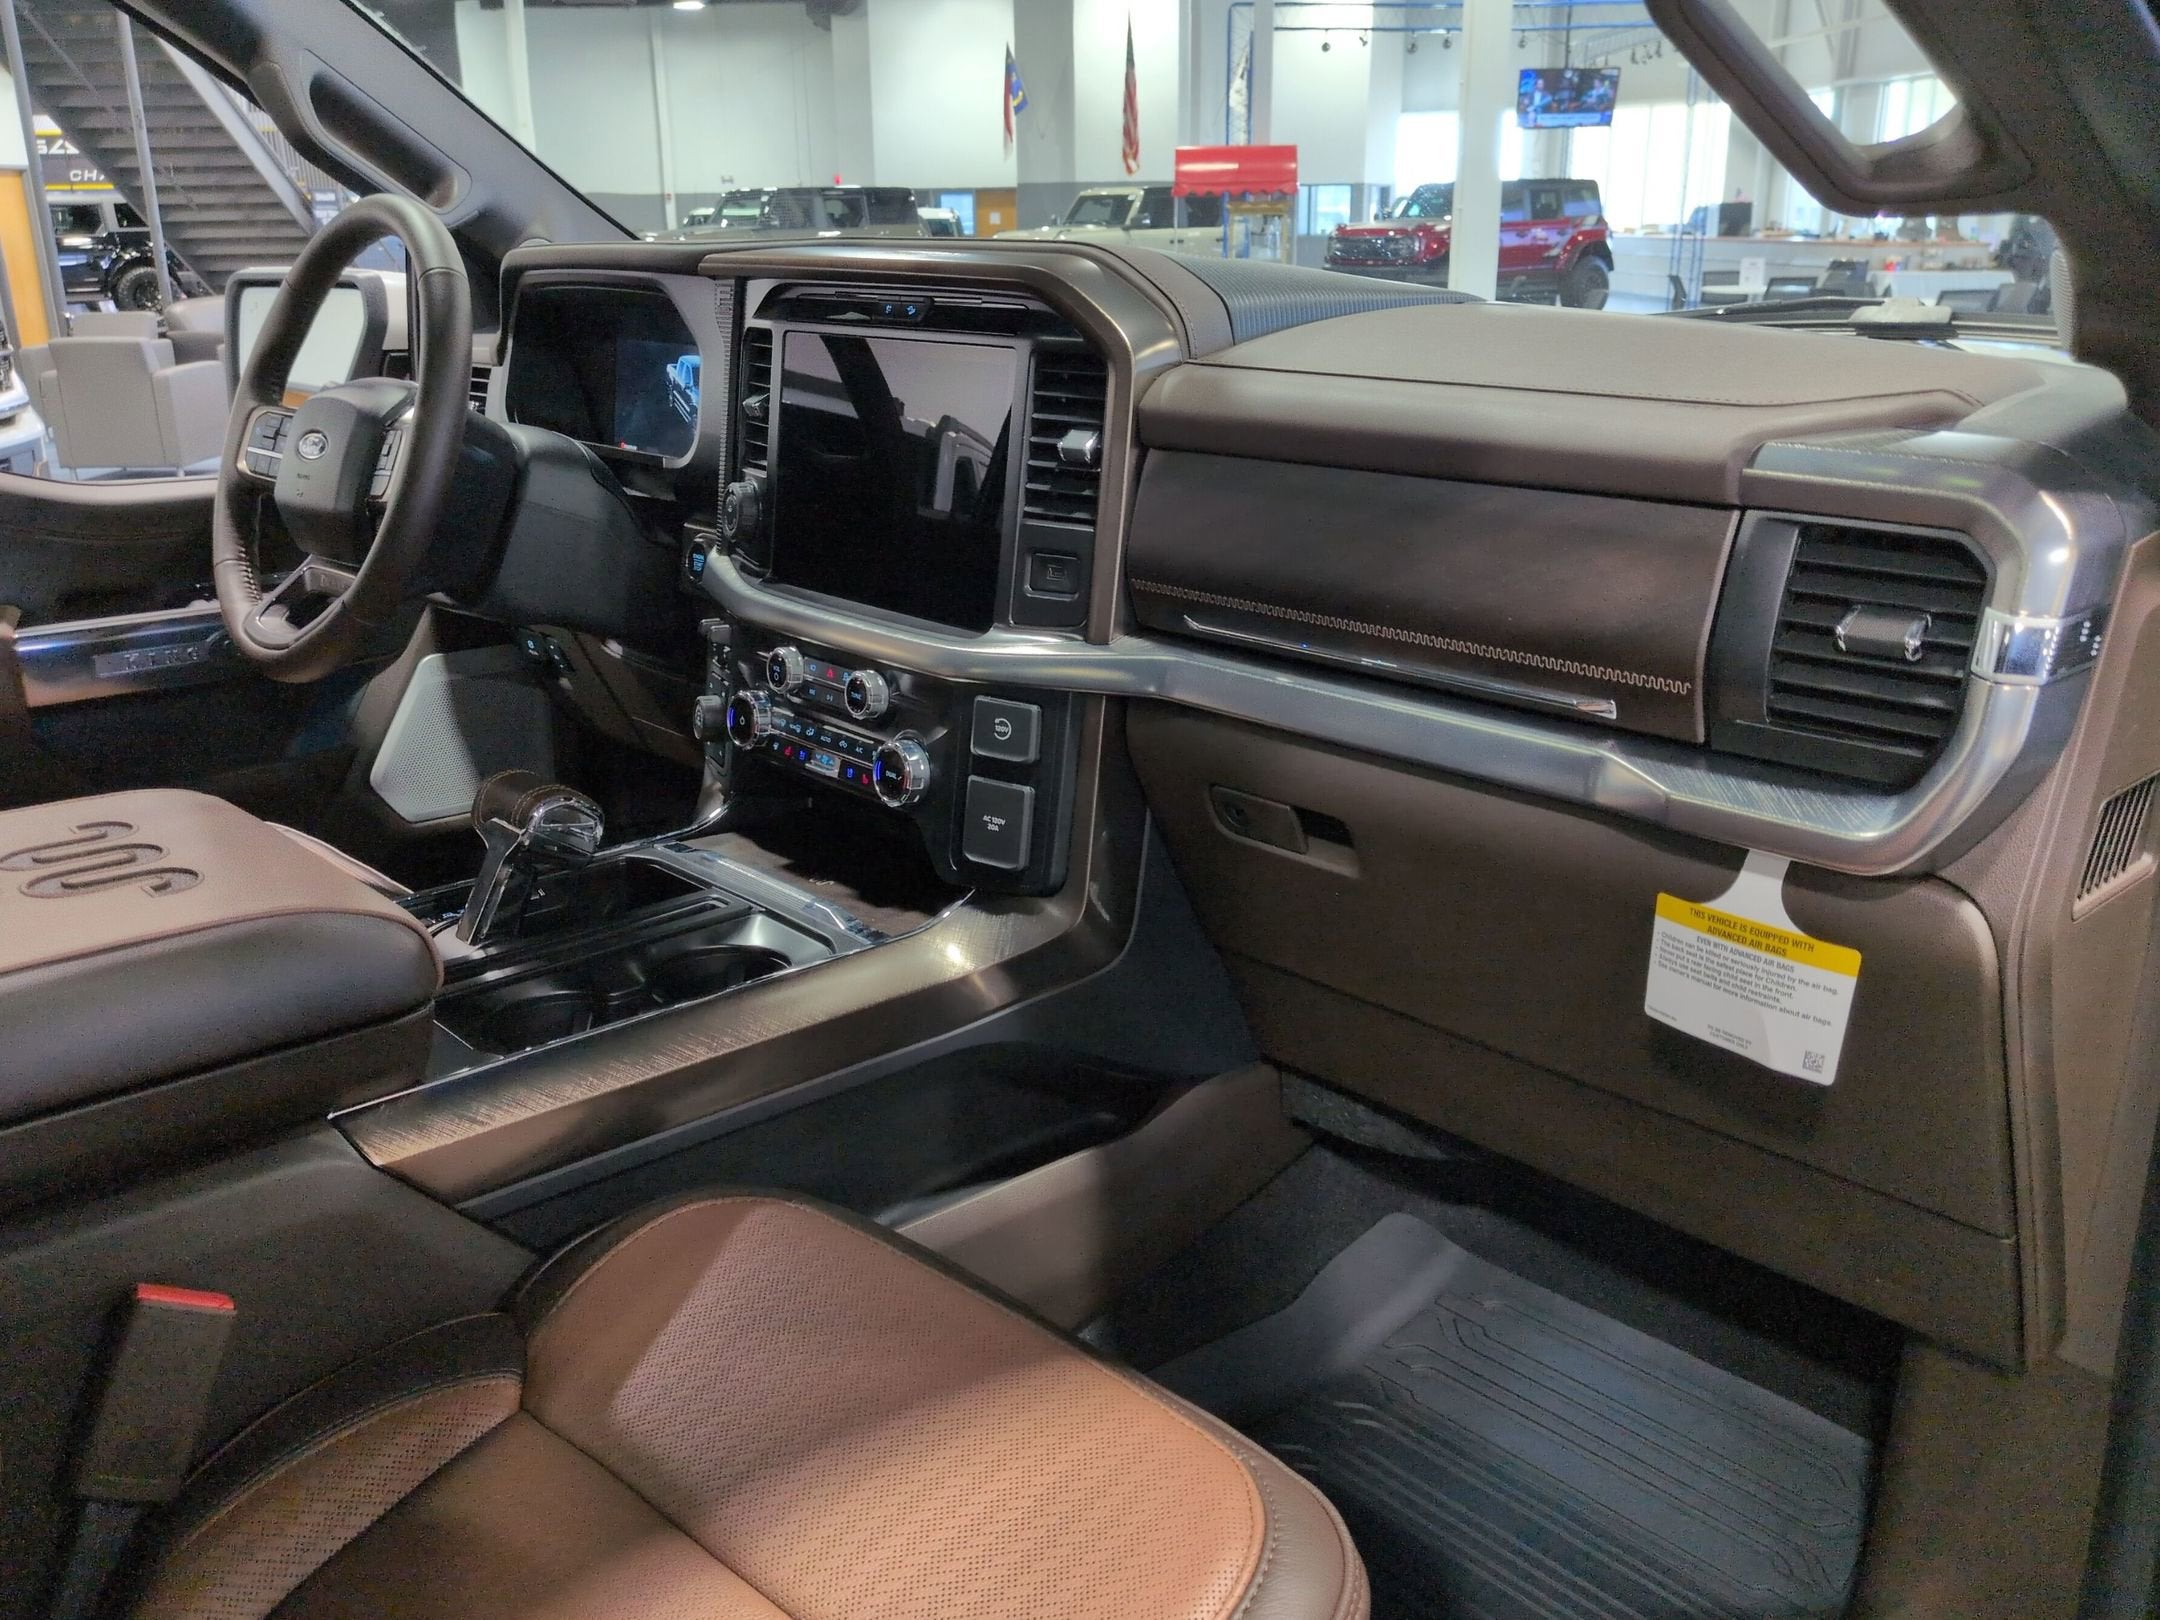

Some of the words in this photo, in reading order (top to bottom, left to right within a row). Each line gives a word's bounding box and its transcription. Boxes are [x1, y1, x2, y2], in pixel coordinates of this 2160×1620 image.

[987, 823, 1000, 832] 20A
[1690, 907, 1705, 919] THIS
[1707, 913, 1738, 929] VEHICLE
[1739, 923, 1747, 932] IS
[1750, 926, 1789, 944] EQUIPPED
[1792, 938, 1814, 953] WITH
[1707, 925, 1747, 944] ADVANCED
[1749, 938, 1763, 950] AIR
[1765, 943, 1787, 957] BAGS
[1661, 939, 1670, 948] The
[1672, 943, 1684, 953] back
[1686, 949, 1697, 957] seat
[1705, 956, 1715, 964] the
[1716, 960, 1734, 972] safest
[1735, 967, 1753, 978] place
[1661, 931, 1684, 945] Children
[1705, 947, 1721, 959] killed
[1731, 958, 1759, 974] seriously
[1761, 967, 1785, 980] injured
[1787, 975, 1795, 984] by
[1798, 978, 1810, 987] the
[1697, 935, 1711, 946] EVEN
[1713, 941, 1729, 952] WITH
[1729, 947, 1762, 963] ADVANCED
[1763, 957, 1775, 967] AIR
[1776, 961, 1794, 973] BAGS
[1658, 960, 1668, 970] See
[1691, 975, 1713, 988] manual
[1723, 987, 1738, 997] more
[1739, 993, 1777, 1009] information
[1779, 1007, 1800, 1017] about
